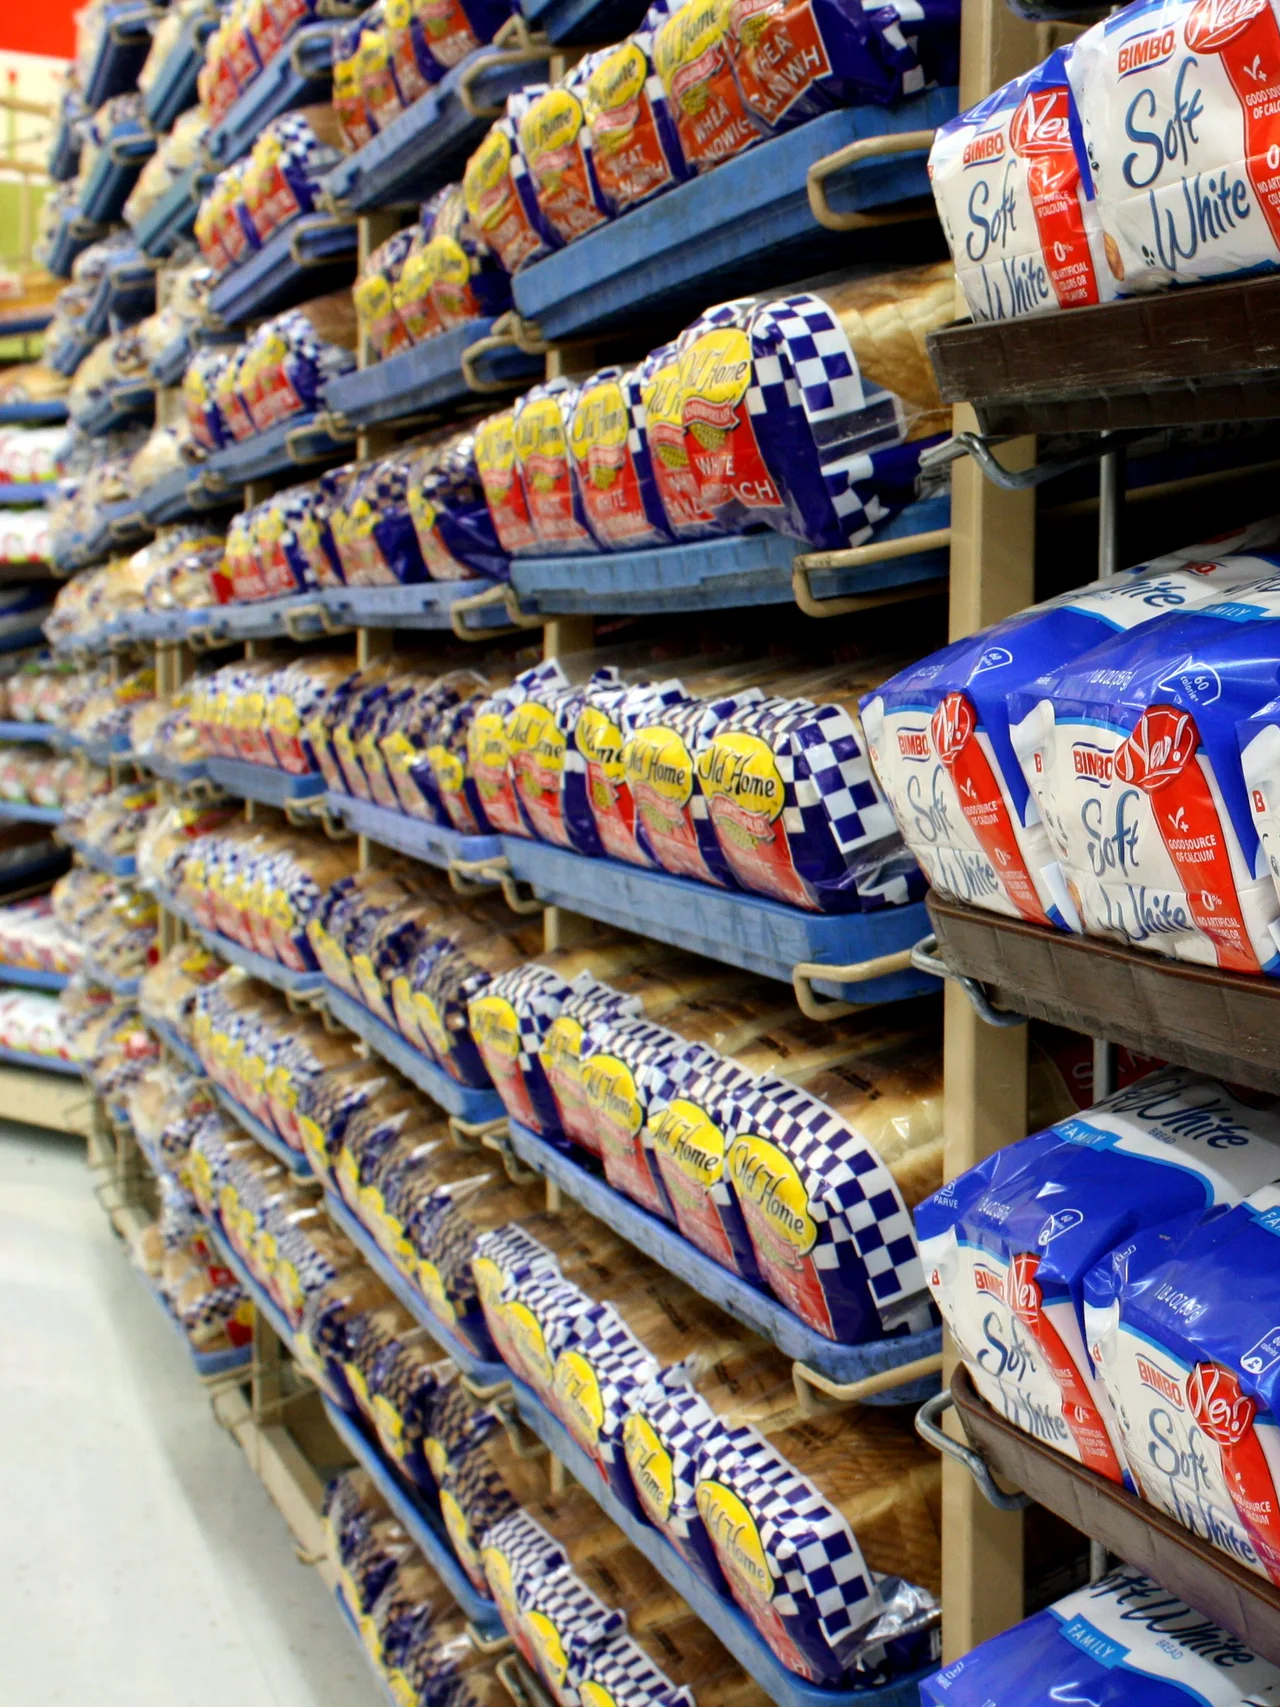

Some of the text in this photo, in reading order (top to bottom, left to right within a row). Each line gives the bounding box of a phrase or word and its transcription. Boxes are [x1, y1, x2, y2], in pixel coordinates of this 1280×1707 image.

[1118, 29, 1176, 74] BIMBO
[1245, 90, 1268, 106] GOOD
[1253, 107, 1264, 120] OF
[1122, 56, 1204, 189] Soft
[962, 133, 1006, 165] BIMBO
[966, 158, 1017, 262] Soft
[1257, 181, 1269, 194] NO
[1149, 171, 1250, 270] White
[1053, 241, 1074, 263] 0%
[980, 255, 1049, 321] White
[1193, 675, 1210, 691] 60
[646, 741, 686, 786] Home
[898, 733, 931, 756] BIMBO
[724, 752, 776, 798] Home
[908, 764, 955, 843] Soft
[1081, 789, 1140, 877] Soft
[1183, 834, 1217, 850] SOURCE
[936, 846, 1000, 901] White
[1184, 849, 1215, 863] CALCIUM
[1100, 882, 1196, 942] White
[1200, 889, 1223, 912] 0%
[673, 1122, 720, 1171] Home
[1059, 1122, 1107, 1145] FAMILY
[734, 1143, 805, 1235] Old Home
[933, 1195, 959, 1209] PARVE
[976, 1311, 1037, 1383] Soft
[1260, 1341, 1279, 1357] calories
[1137, 1359, 1184, 1408] BIMBO
[1148, 1407, 1211, 1493] Soft
[1169, 1476, 1257, 1565] White
[723, 1517, 766, 1582] Home
[1067, 1623, 1116, 1660] FAMILY
[1121, 1596, 1257, 1669] White
[1155, 1638, 1184, 1661] BREAD
